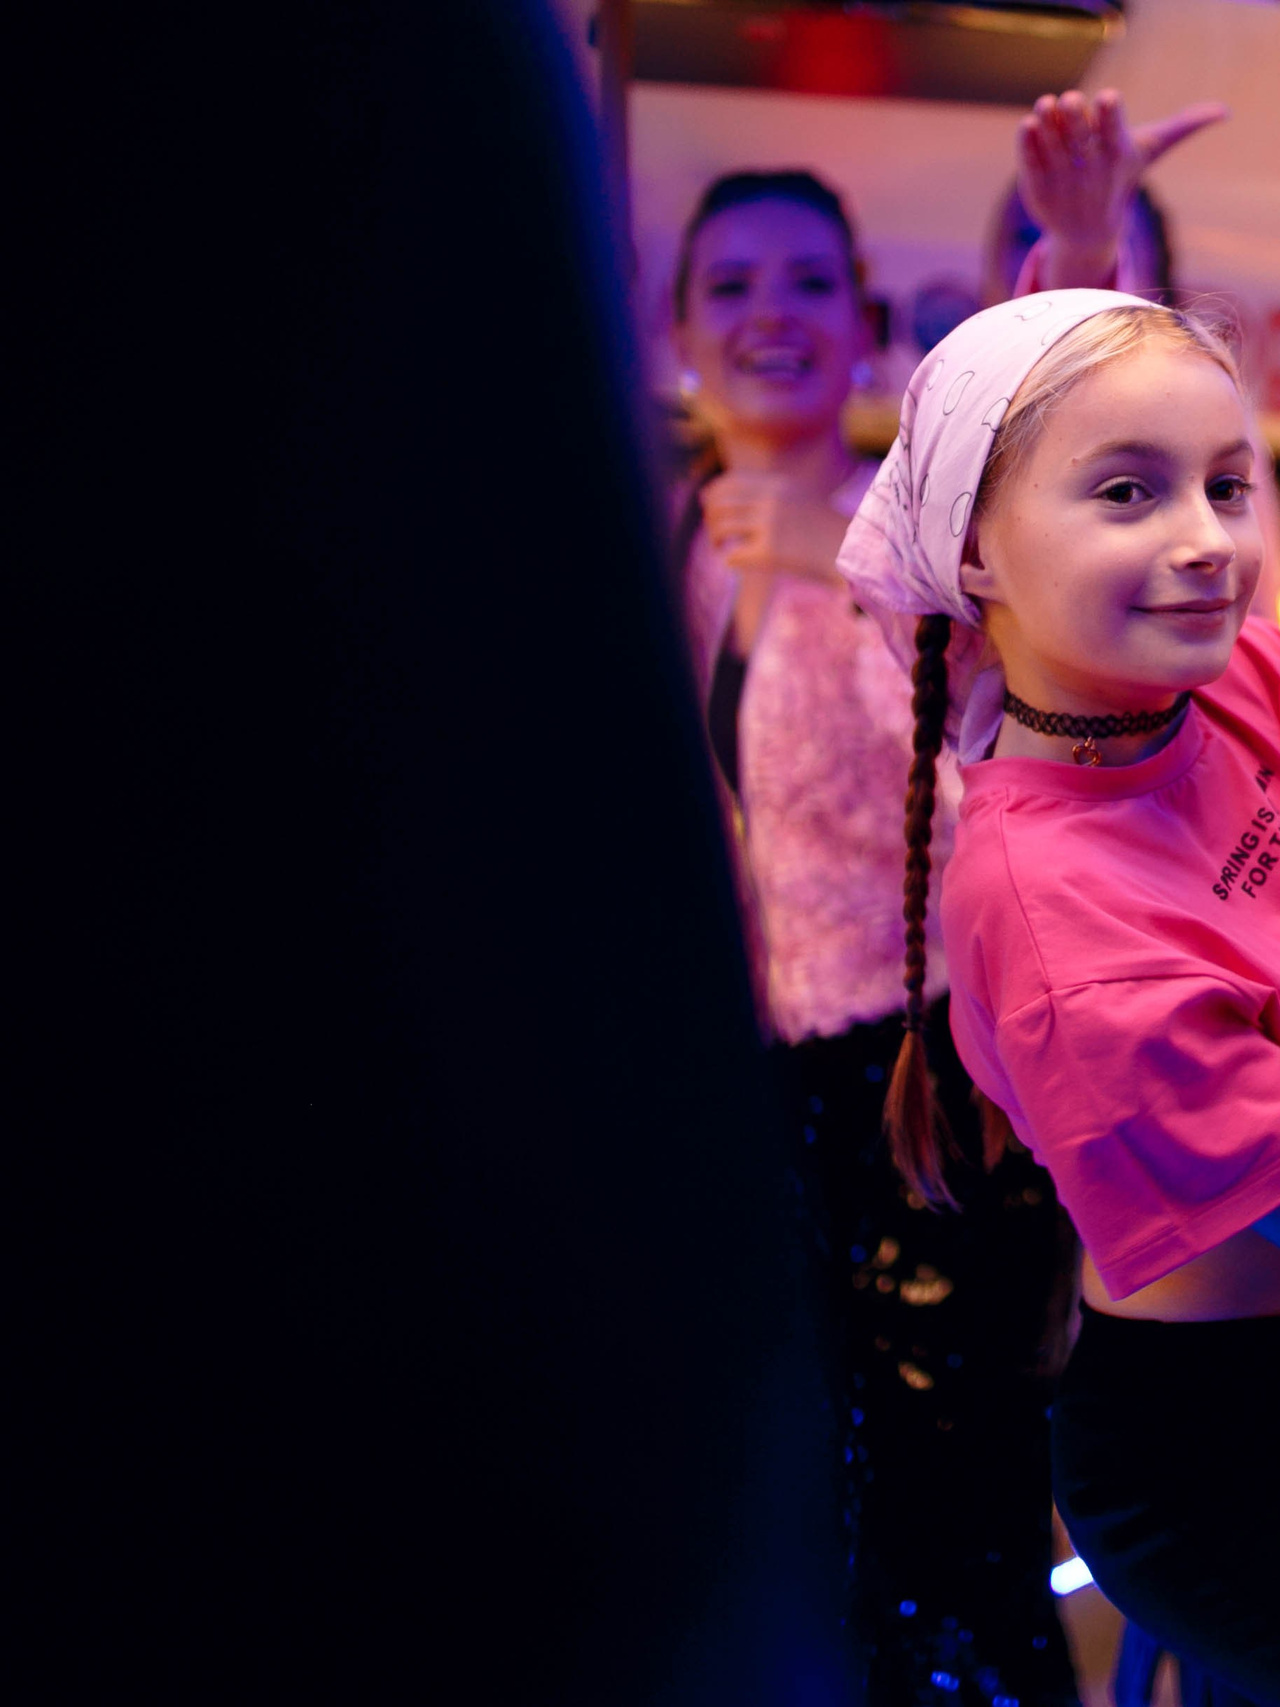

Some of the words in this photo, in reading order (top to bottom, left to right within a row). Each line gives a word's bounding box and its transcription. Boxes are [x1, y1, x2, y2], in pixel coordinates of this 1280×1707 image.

[1212, 832, 1260, 901] SPRING
[1251, 807, 1275, 832] IS
[1241, 852, 1279, 899] FOR
